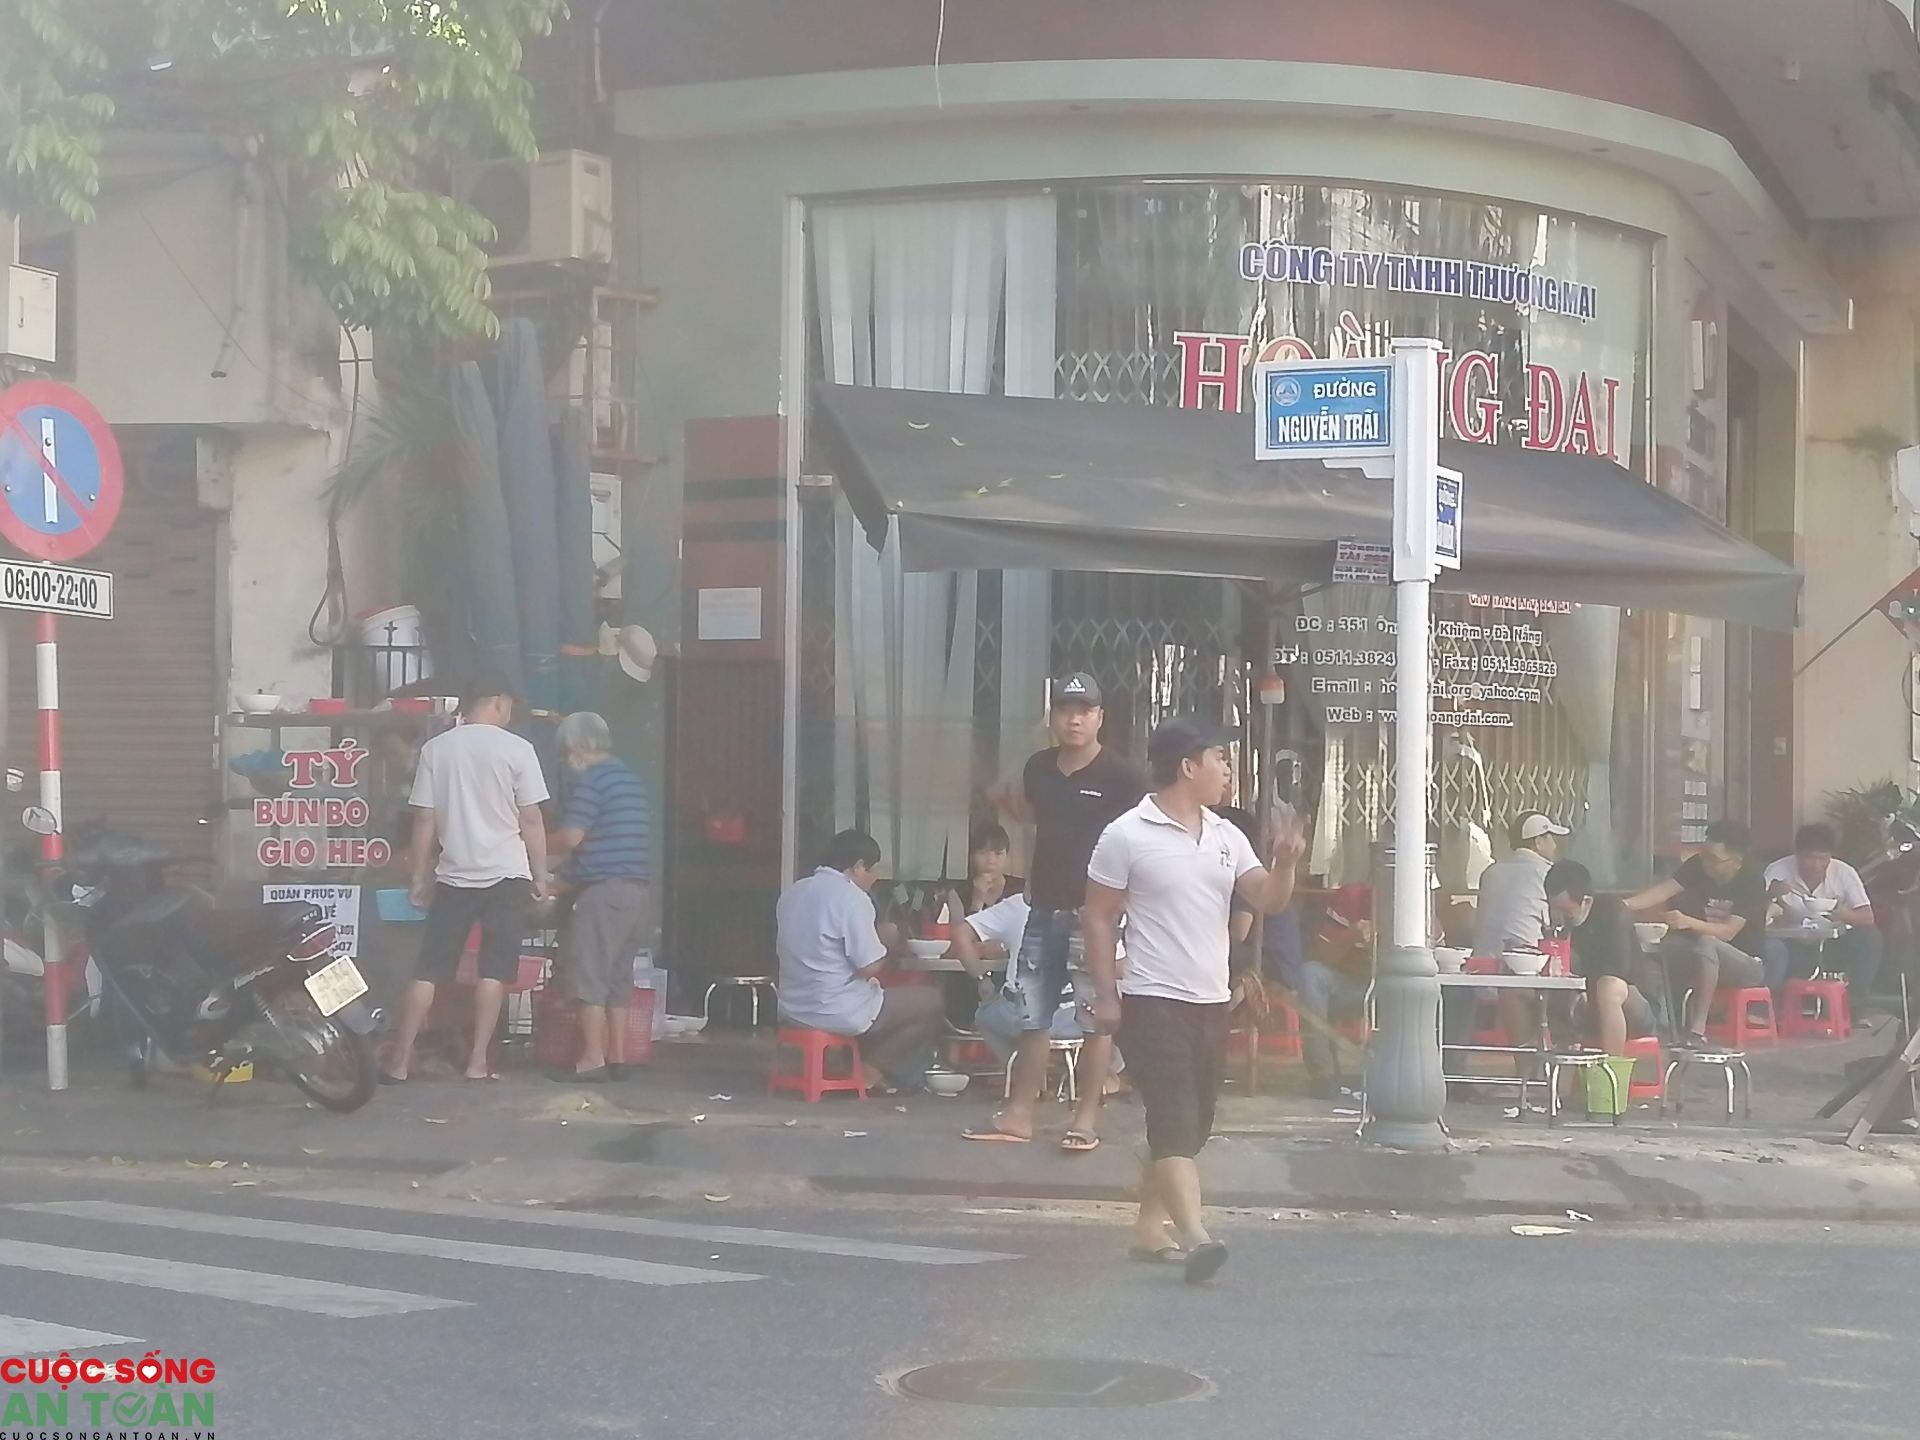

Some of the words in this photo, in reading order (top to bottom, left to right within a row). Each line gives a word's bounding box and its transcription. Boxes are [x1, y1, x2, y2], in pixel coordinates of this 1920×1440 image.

[1240, 238, 1335, 285] CÔNG
[1340, 251, 1381, 289] TY
[1384, 253, 1463, 297] TNHH
[1467, 260, 1559, 313] THƯƠNG
[1560, 281, 1598, 324] MẠI
[1313, 376, 1377, 399] ĐƯỜNG
[1278, 406, 1340, 443] NGUYỄN
[1343, 408, 1379, 441] TRÃI
[4, 567, 98, 609] 06:00-22:00
[1339, 617, 1368, 632] 351
[1375, 615, 1397, 634] Ôn
[1493, 624, 1511, 641] Đà
[1443, 653, 1470, 669] Fax
[1311, 677, 1359, 693] Email
[1326, 706, 1362, 722] Web
[281, 738, 369, 788] TỶ
[254, 792, 320, 827] BÚN
[325, 837, 391, 867] HEO
